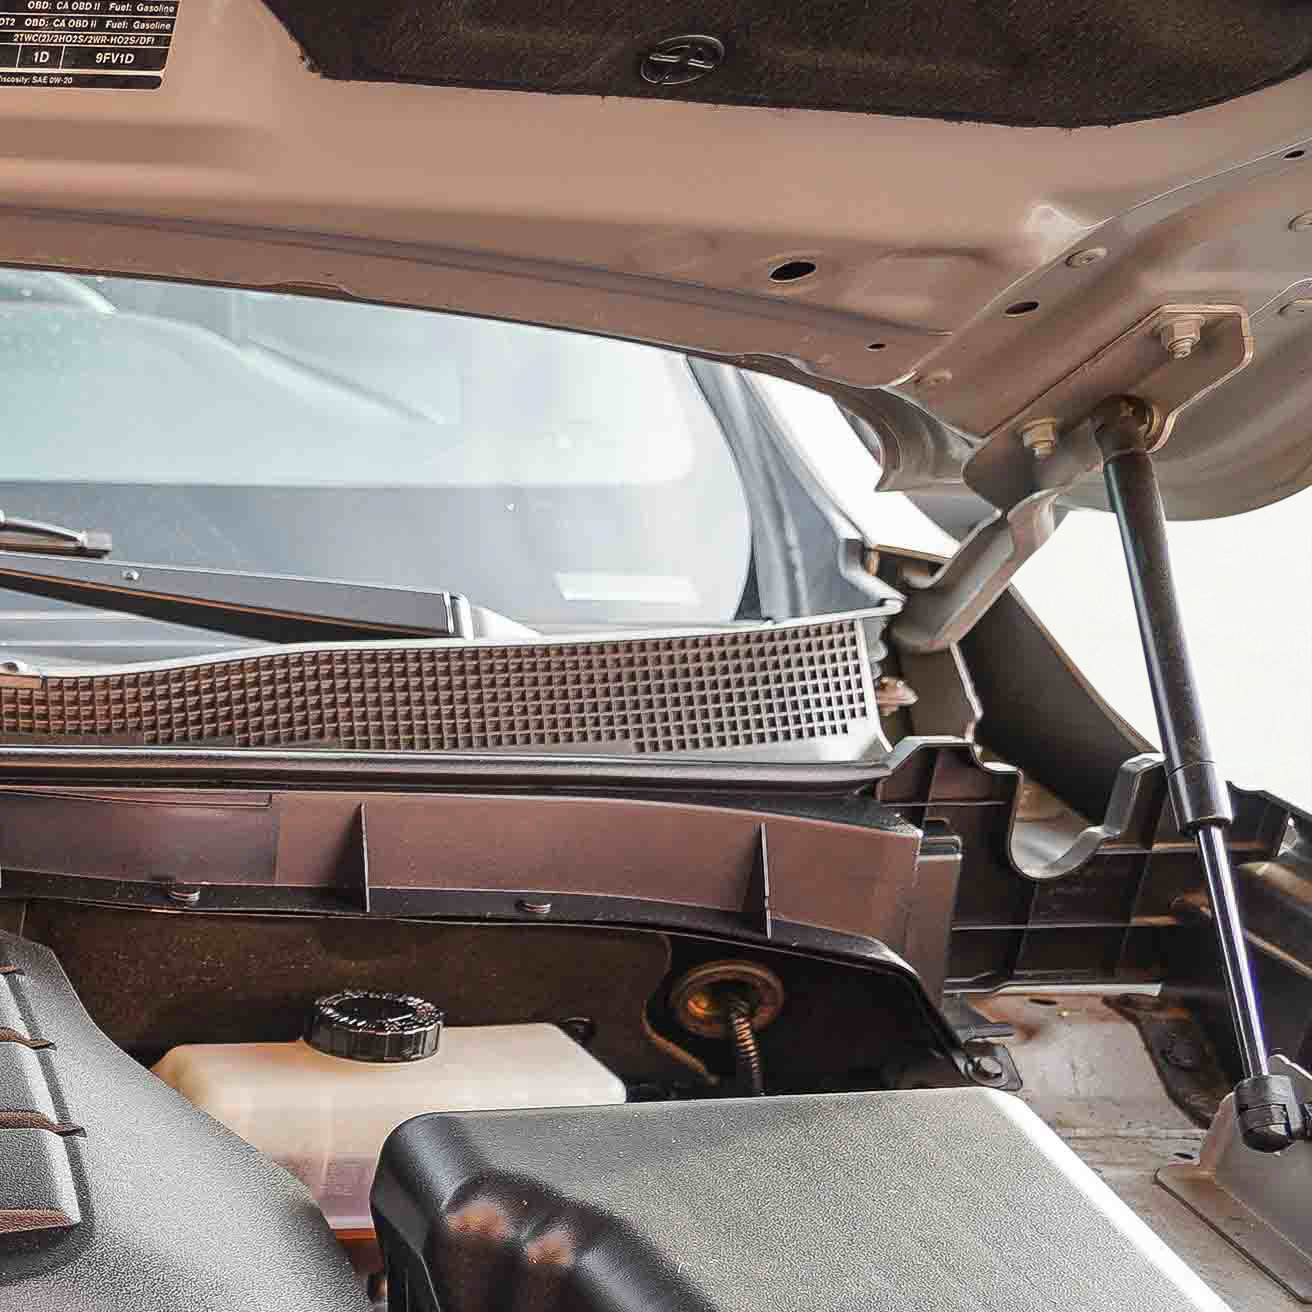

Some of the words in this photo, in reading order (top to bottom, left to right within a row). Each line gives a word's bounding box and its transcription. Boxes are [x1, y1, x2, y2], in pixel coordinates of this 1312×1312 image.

[27, 1, 52, 10] OBD:
[56, 2, 69, 10] CA
[71, 2, 93, 11] OBD
[109, 3, 133, 12] Fuel:
[136, 4, 175, 13] Gasoline
[53, 19, 66, 27] CA
[105, 20, 128, 29] Fuel:
[133, 21, 172, 30] Gasoline
[33, 52, 50, 63] 1D
[95, 52, 135, 64] 9FV1D
[32, 75, 48, 83] SAE
